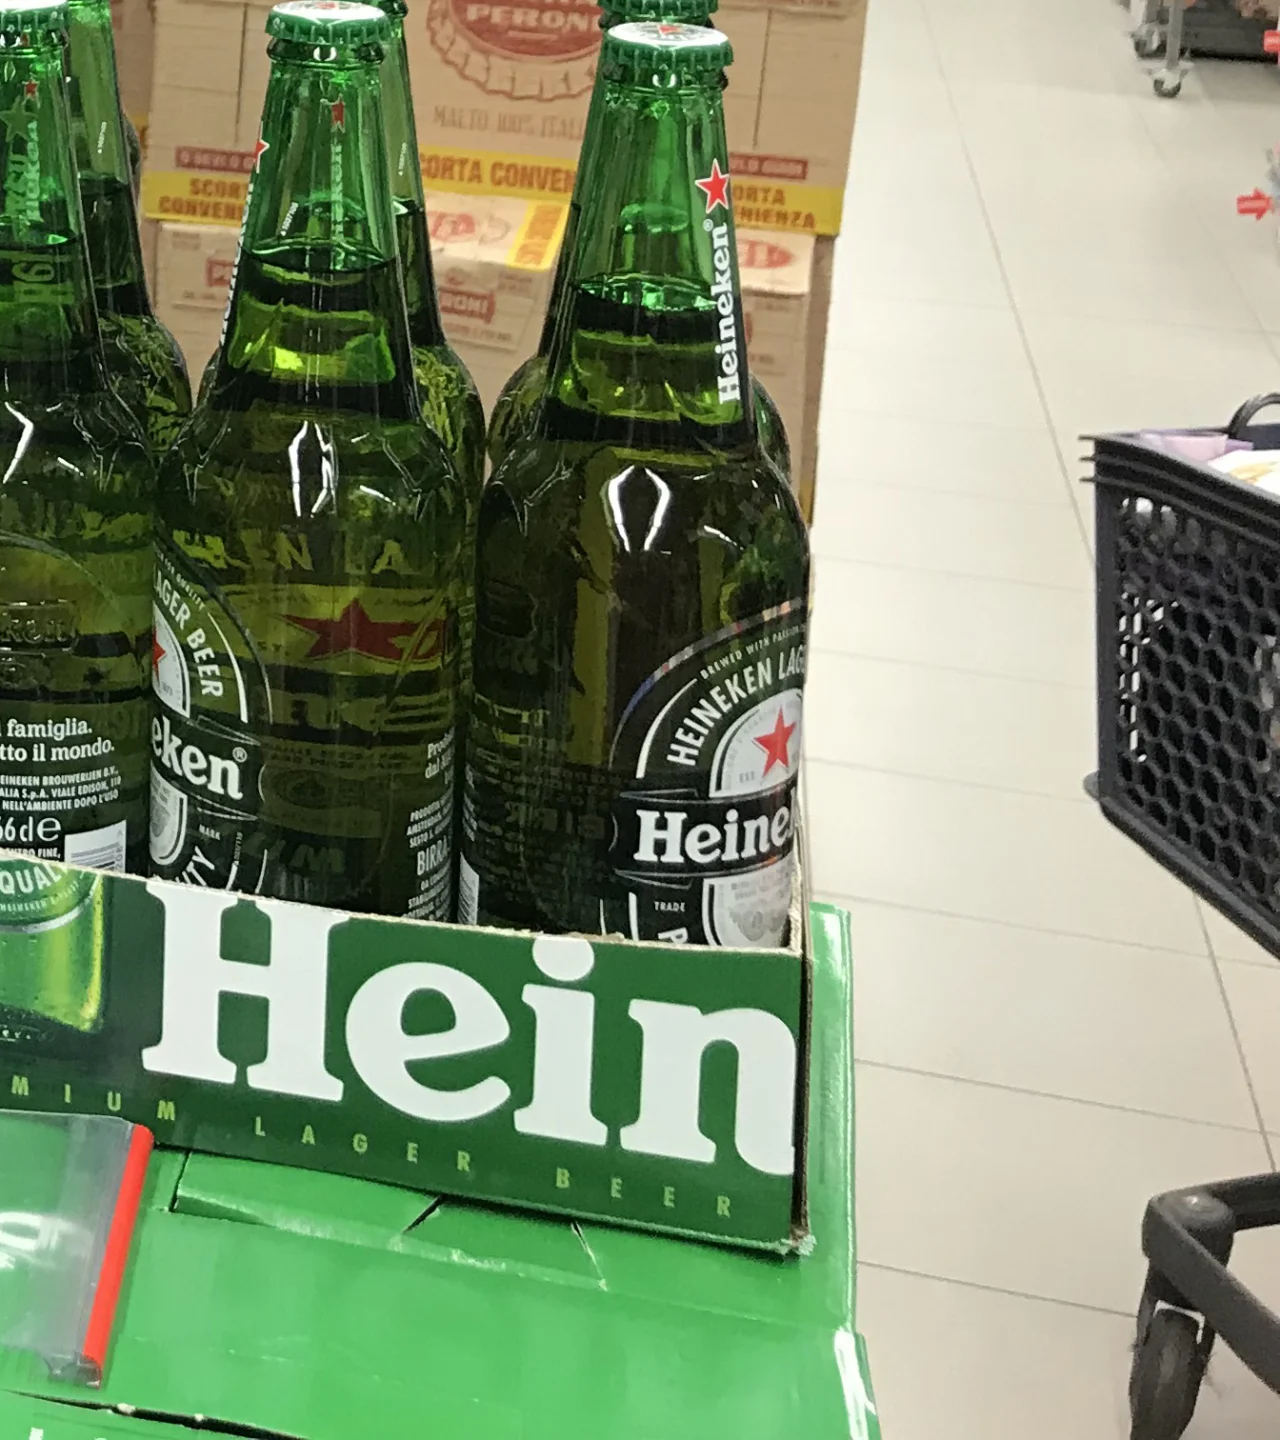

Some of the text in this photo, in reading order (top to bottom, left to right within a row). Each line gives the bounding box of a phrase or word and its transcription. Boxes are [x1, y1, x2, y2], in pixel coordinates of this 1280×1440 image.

[710, 221, 741, 405] Heineken
[186, 628, 223, 698] BEER
[700, 636, 770, 679] BREWED WITH
[666, 657, 773, 767] HEINEKEN
[6, 718, 93, 741] famiglia.
[33, 743, 46, 762] il
[51, 737, 115, 761] mondo.
[42, 769, 101, 787] BROUWERIJEN
[2, 799, 72, 811] NELL'AMBIENTE
[74, 796, 96, 809] DOPO
[99, 790, 119, 805] L'USO
[21, 788, 49, 800] S.p.A.
[51, 786, 75, 797] VIALE
[19, 815, 34, 841] cl
[653, 901, 686, 913] TRADE
